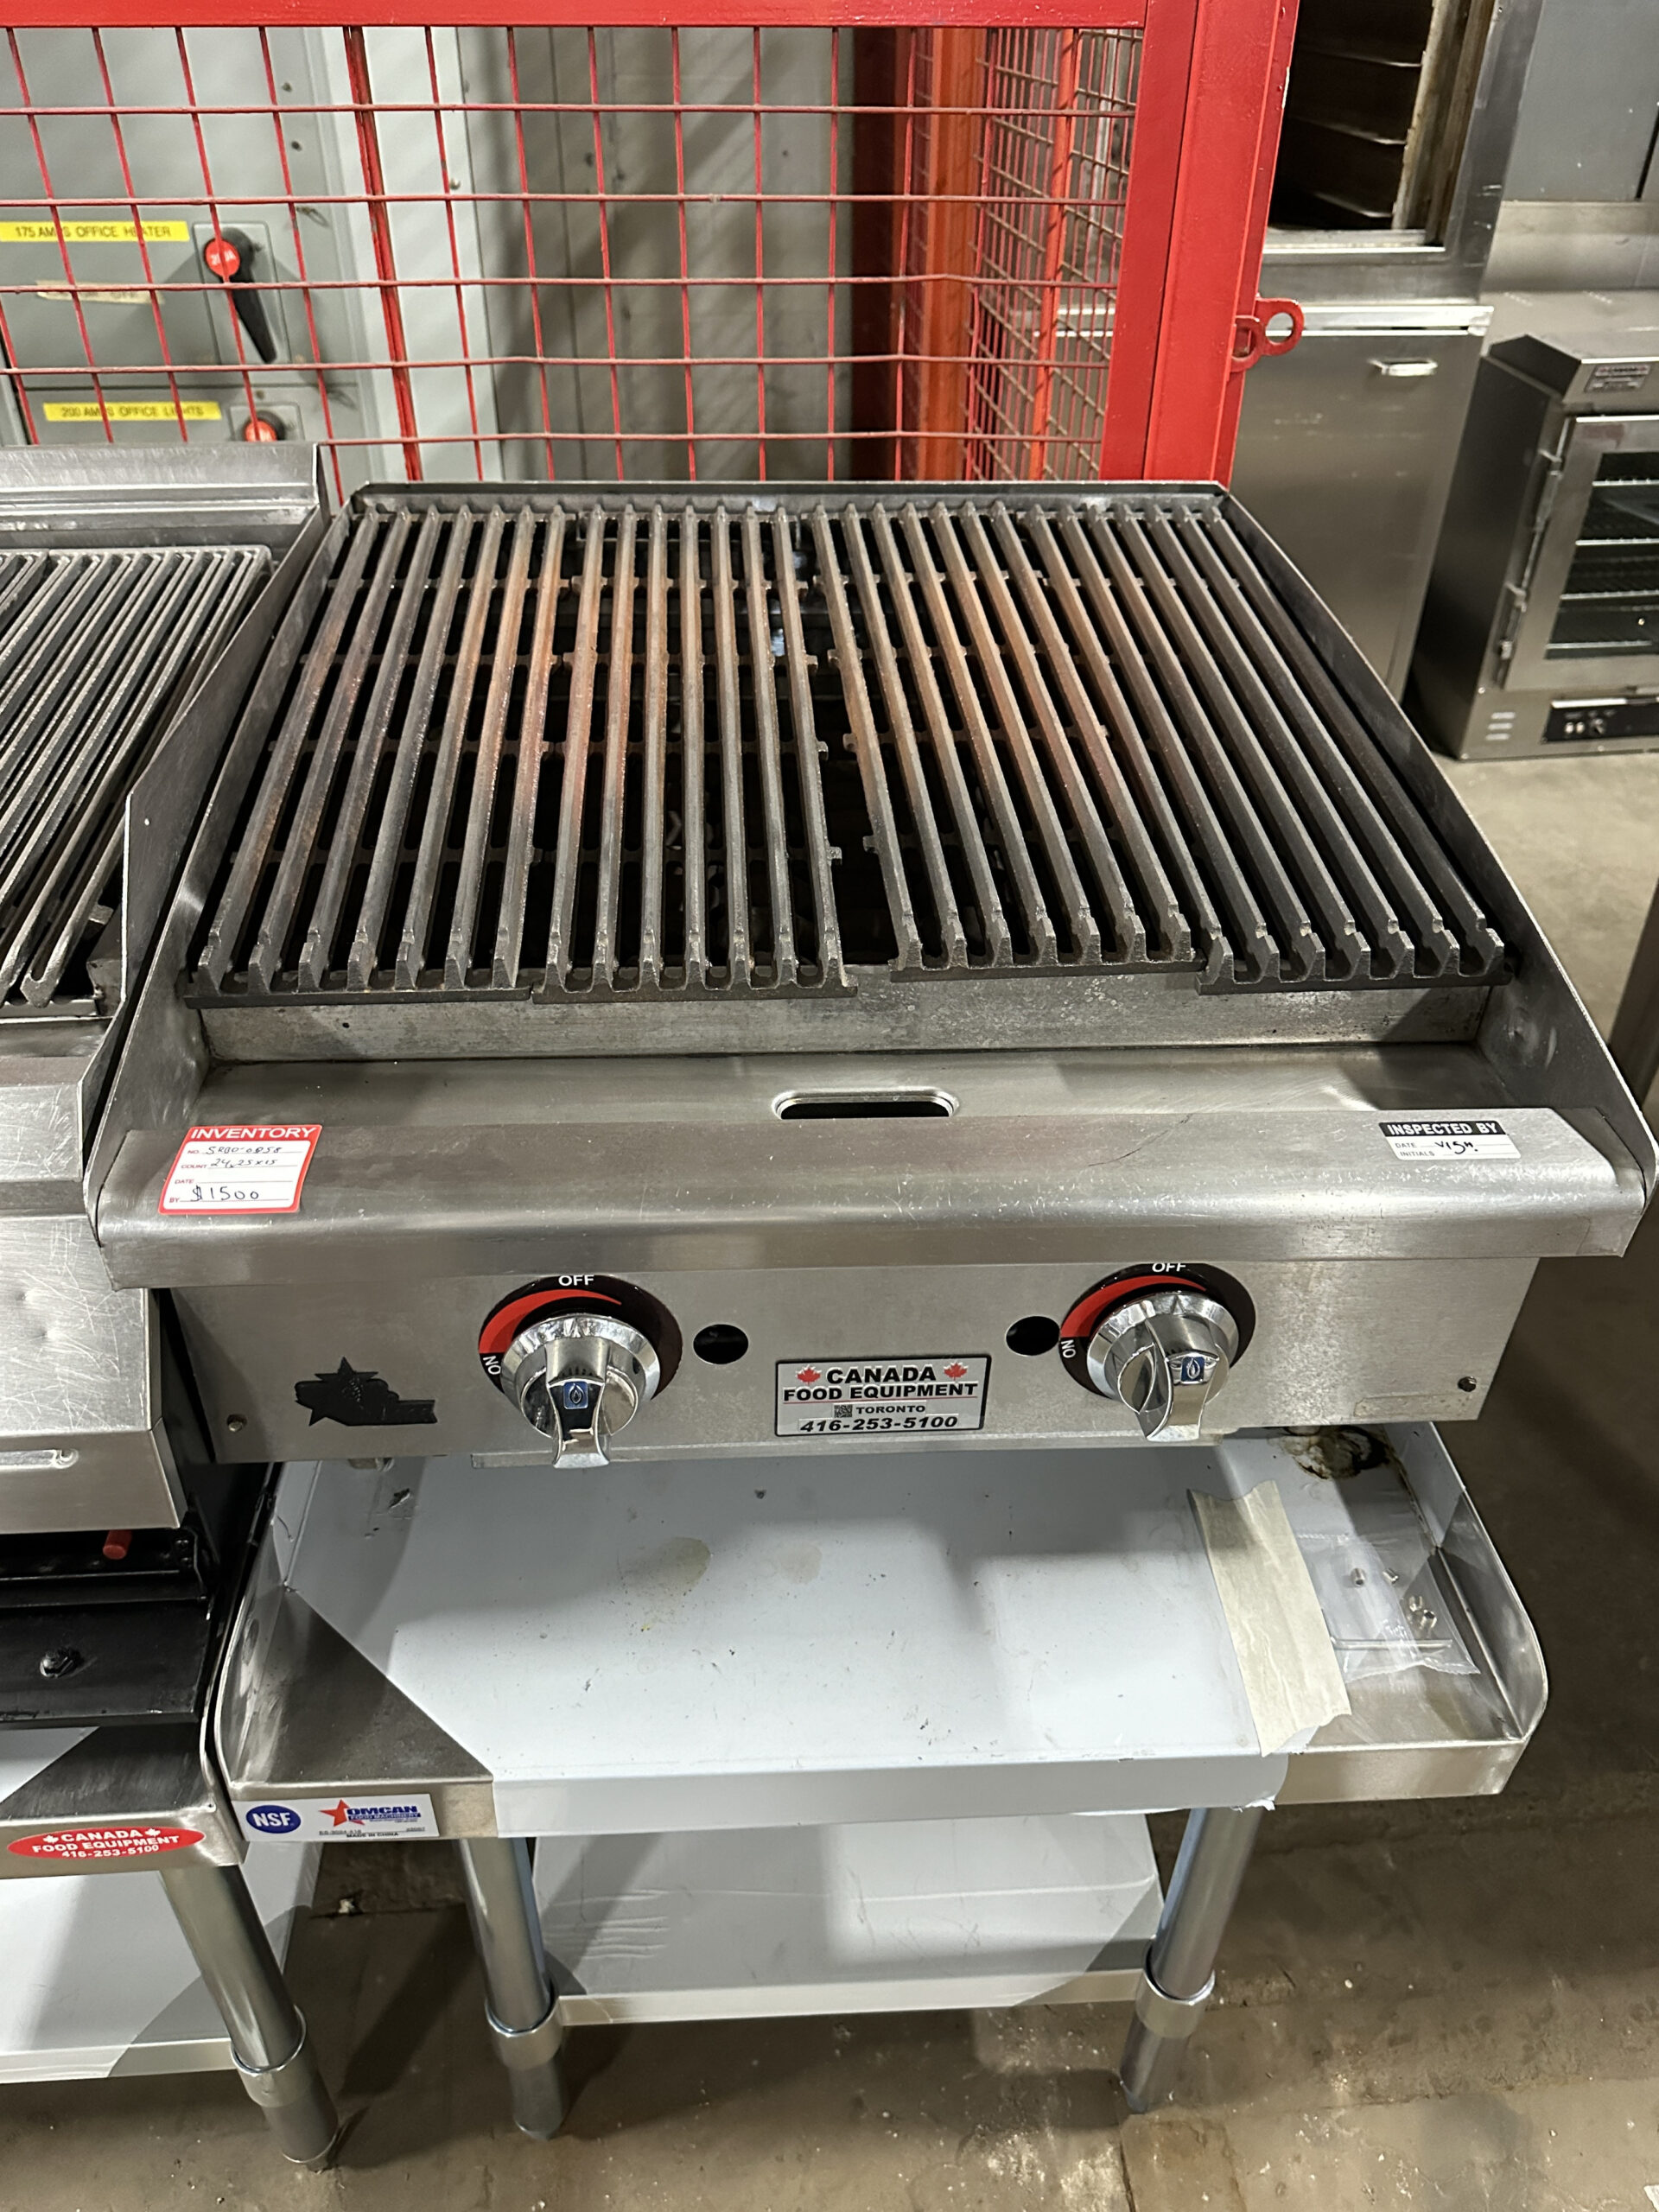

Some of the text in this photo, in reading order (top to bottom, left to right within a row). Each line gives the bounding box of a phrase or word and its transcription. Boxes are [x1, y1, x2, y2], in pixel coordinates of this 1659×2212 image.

[16, 226, 35, 238] 175
[38, 226, 72, 238] AMS
[76, 226, 118, 238] OFFICE
[84, 406, 115, 416] AMS
[118, 405, 158, 416] OFFICE
[191, 1128, 317, 1139] INVENTORY
[1387, 1123, 1498, 1135] INSPECTED BY
[191, 1185, 259, 1202] $1500
[1152, 1262, 1186, 1273] OFF
[558, 1274, 594, 1287] OFF
[1060, 1339, 1077, 1358] ON
[482, 1356, 502, 1376] ON
[826, 1364, 937, 1384] CANADA
[783, 1383, 978, 1402] FOOD EQUIPMENT
[855, 1405, 926, 1414] TORONTO
[799, 1416, 958, 1433] 416-253-5100
[346, 1806, 418, 1815] OMCAN
[253, 1813, 292, 1827] NSF
[60, 1829, 143, 1842] CANADA
[32, 1835, 180, 1853] FOOD EQUIPMENT
[61, 1844, 160, 1858] 416-253-5100
